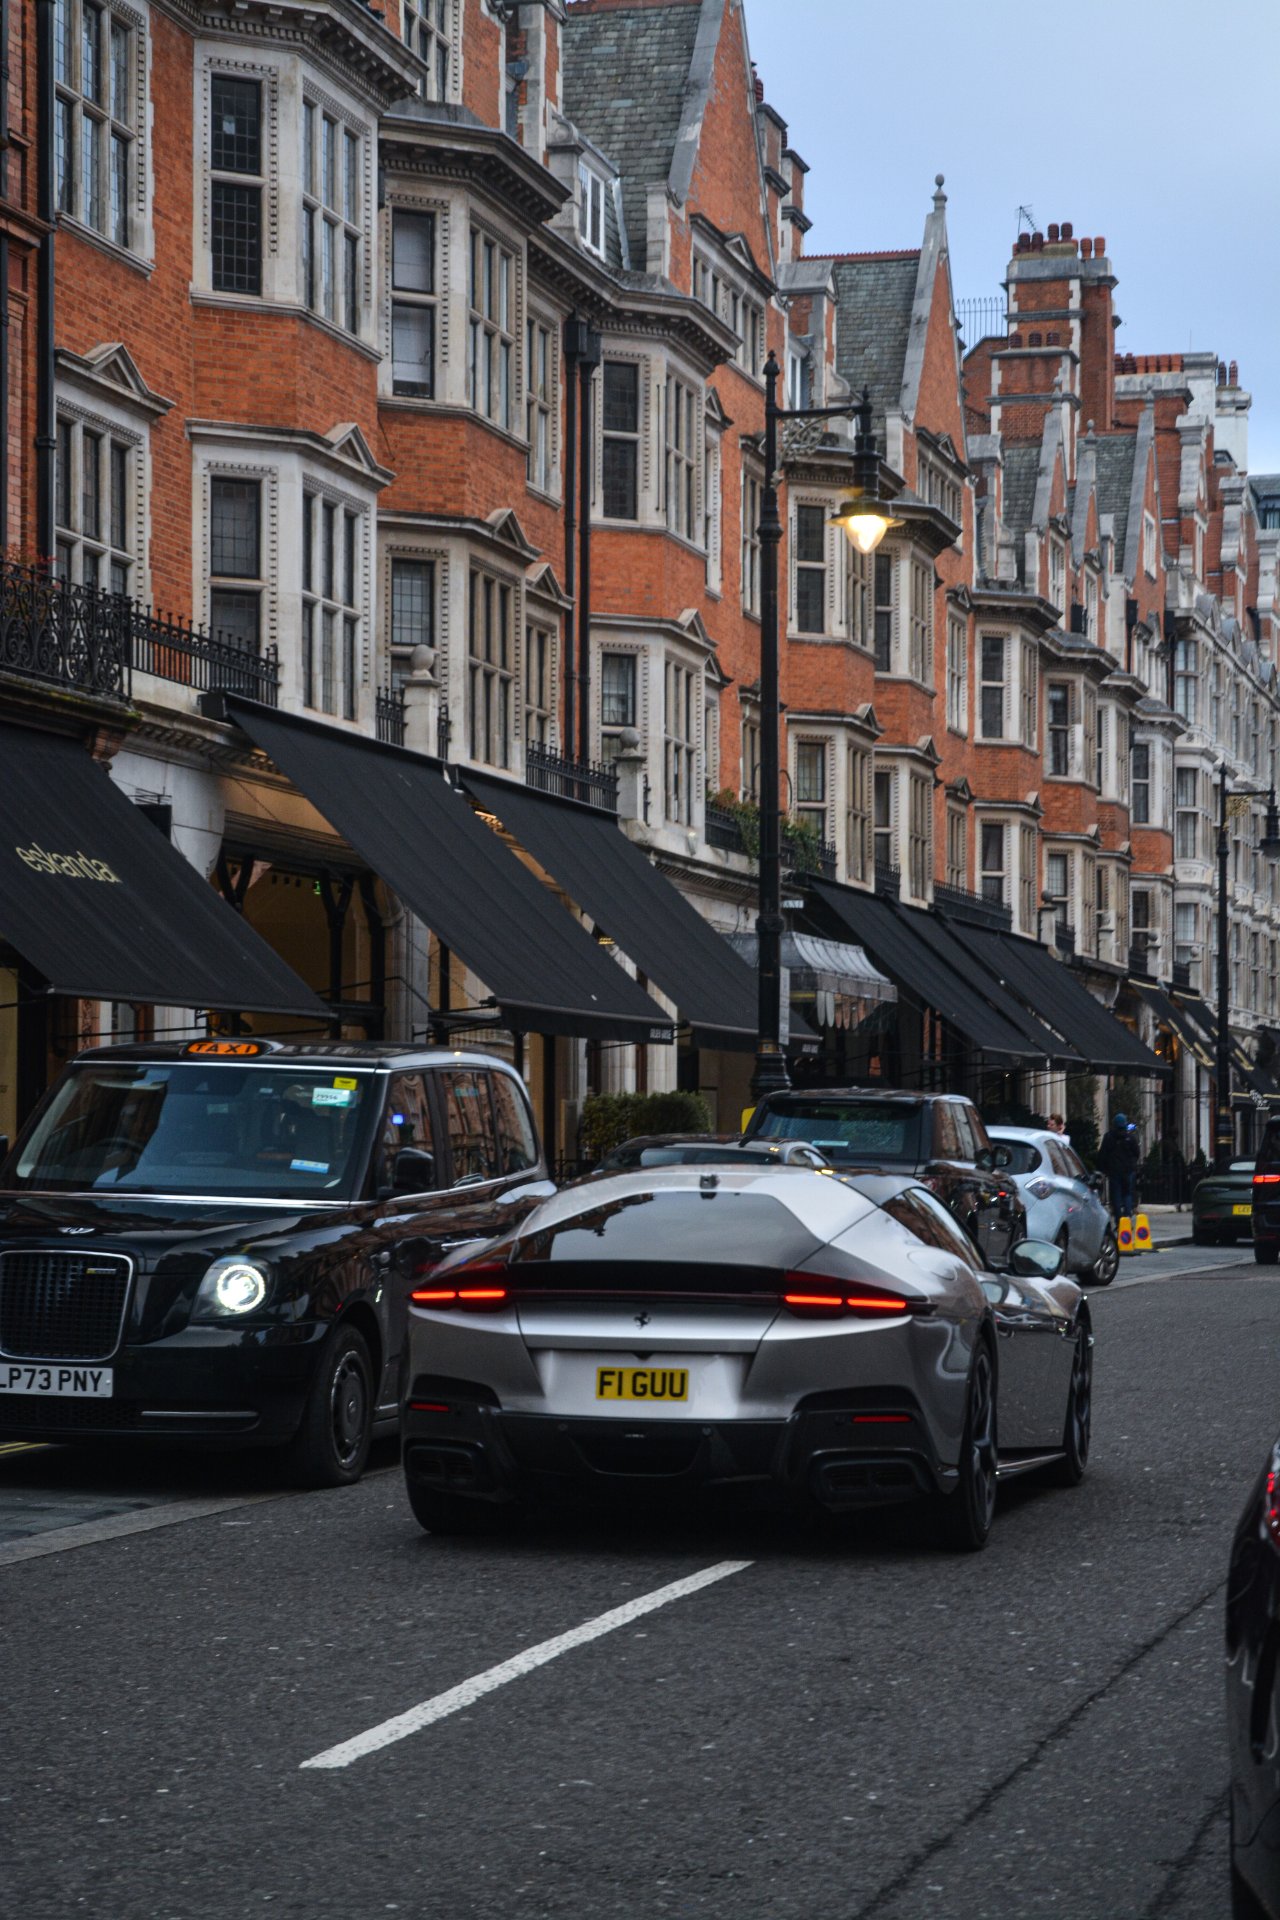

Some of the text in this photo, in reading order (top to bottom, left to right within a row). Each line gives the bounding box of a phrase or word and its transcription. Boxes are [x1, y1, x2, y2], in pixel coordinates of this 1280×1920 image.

[195, 1043, 252, 1053] TAXI
[58, 1369, 102, 1392] PNY
[632, 1371, 686, 1398] GUU
